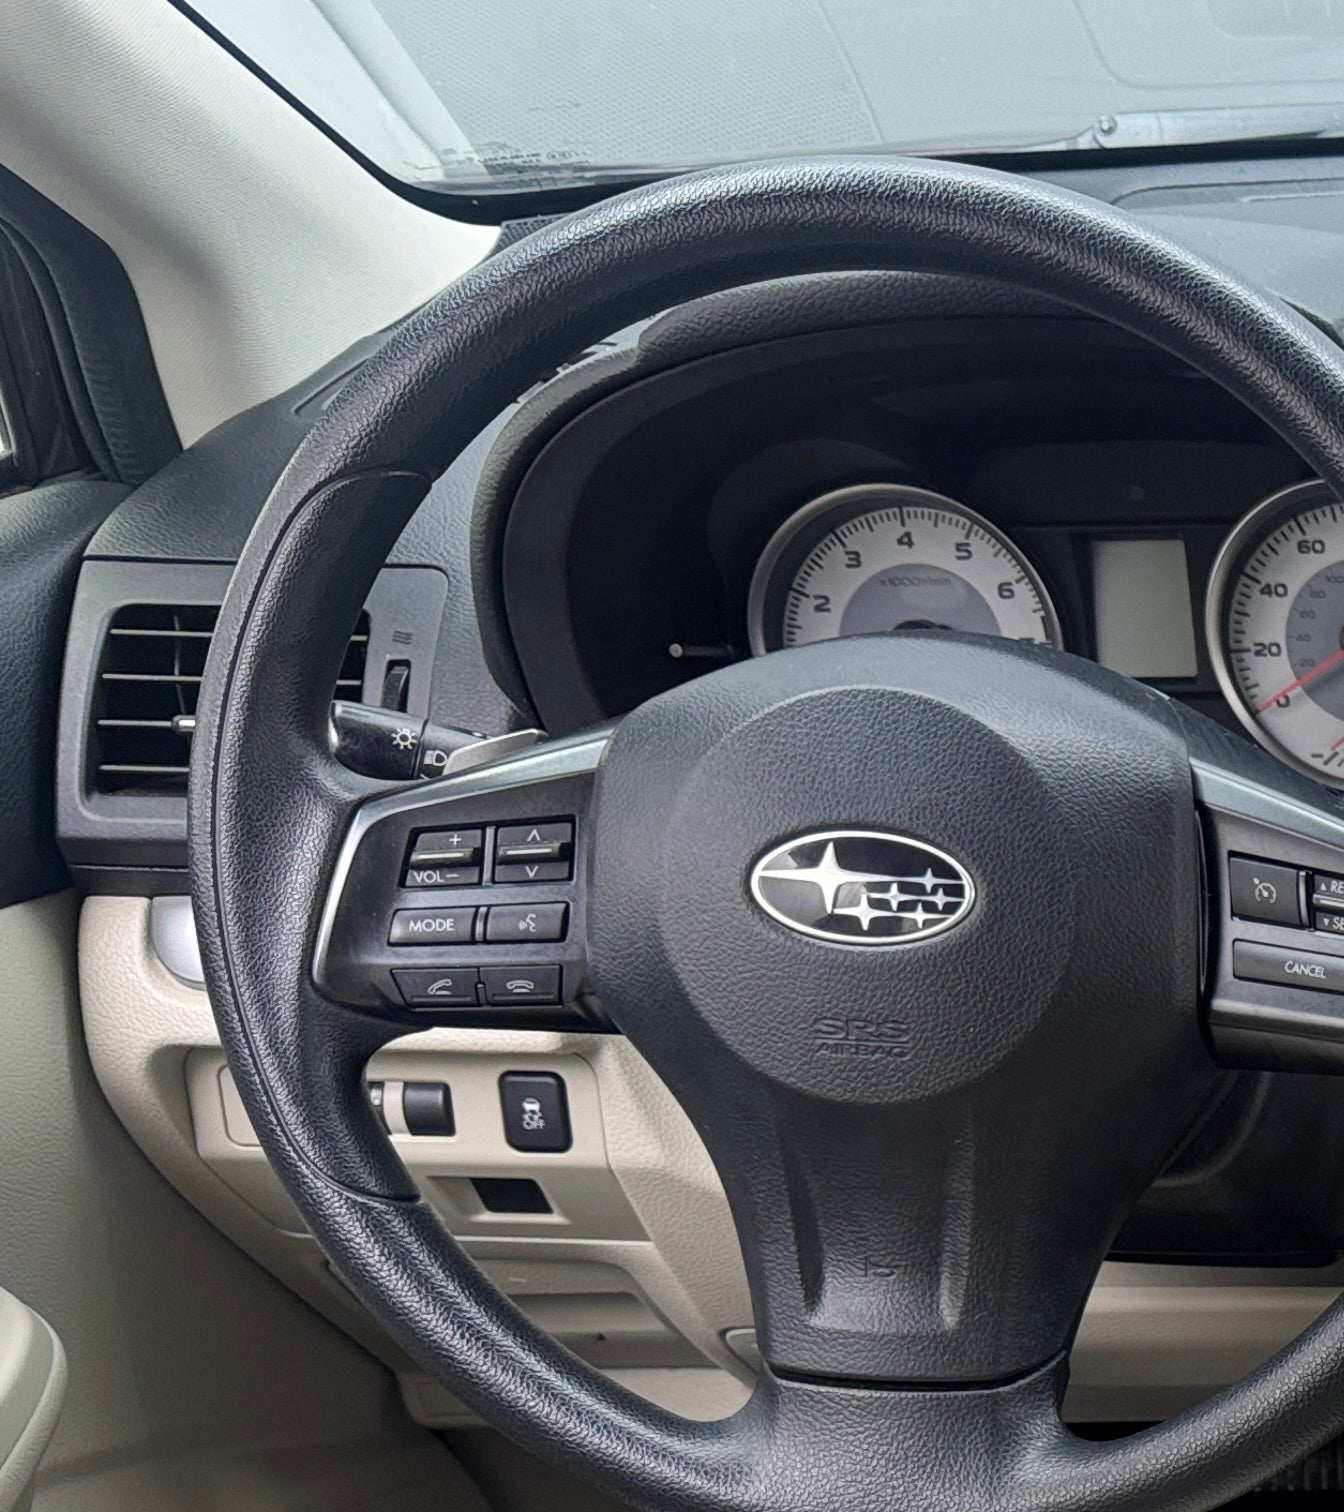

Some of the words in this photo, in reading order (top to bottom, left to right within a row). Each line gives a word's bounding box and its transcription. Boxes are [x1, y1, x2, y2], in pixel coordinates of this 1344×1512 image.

[896, 531, 914, 549] 4
[1297, 539, 1325, 554] 60
[845, 550, 862, 569] 3
[955, 542, 973, 561] 5
[997, 581, 1015, 600] 6
[1259, 583, 1288, 598] 40
[813, 594, 831, 613] 2
[1253, 642, 1282, 657] 20
[408, 918, 455, 932] MODE
[1284, 961, 1327, 979] CANCEL
[814, 1016, 912, 1042] SRS
